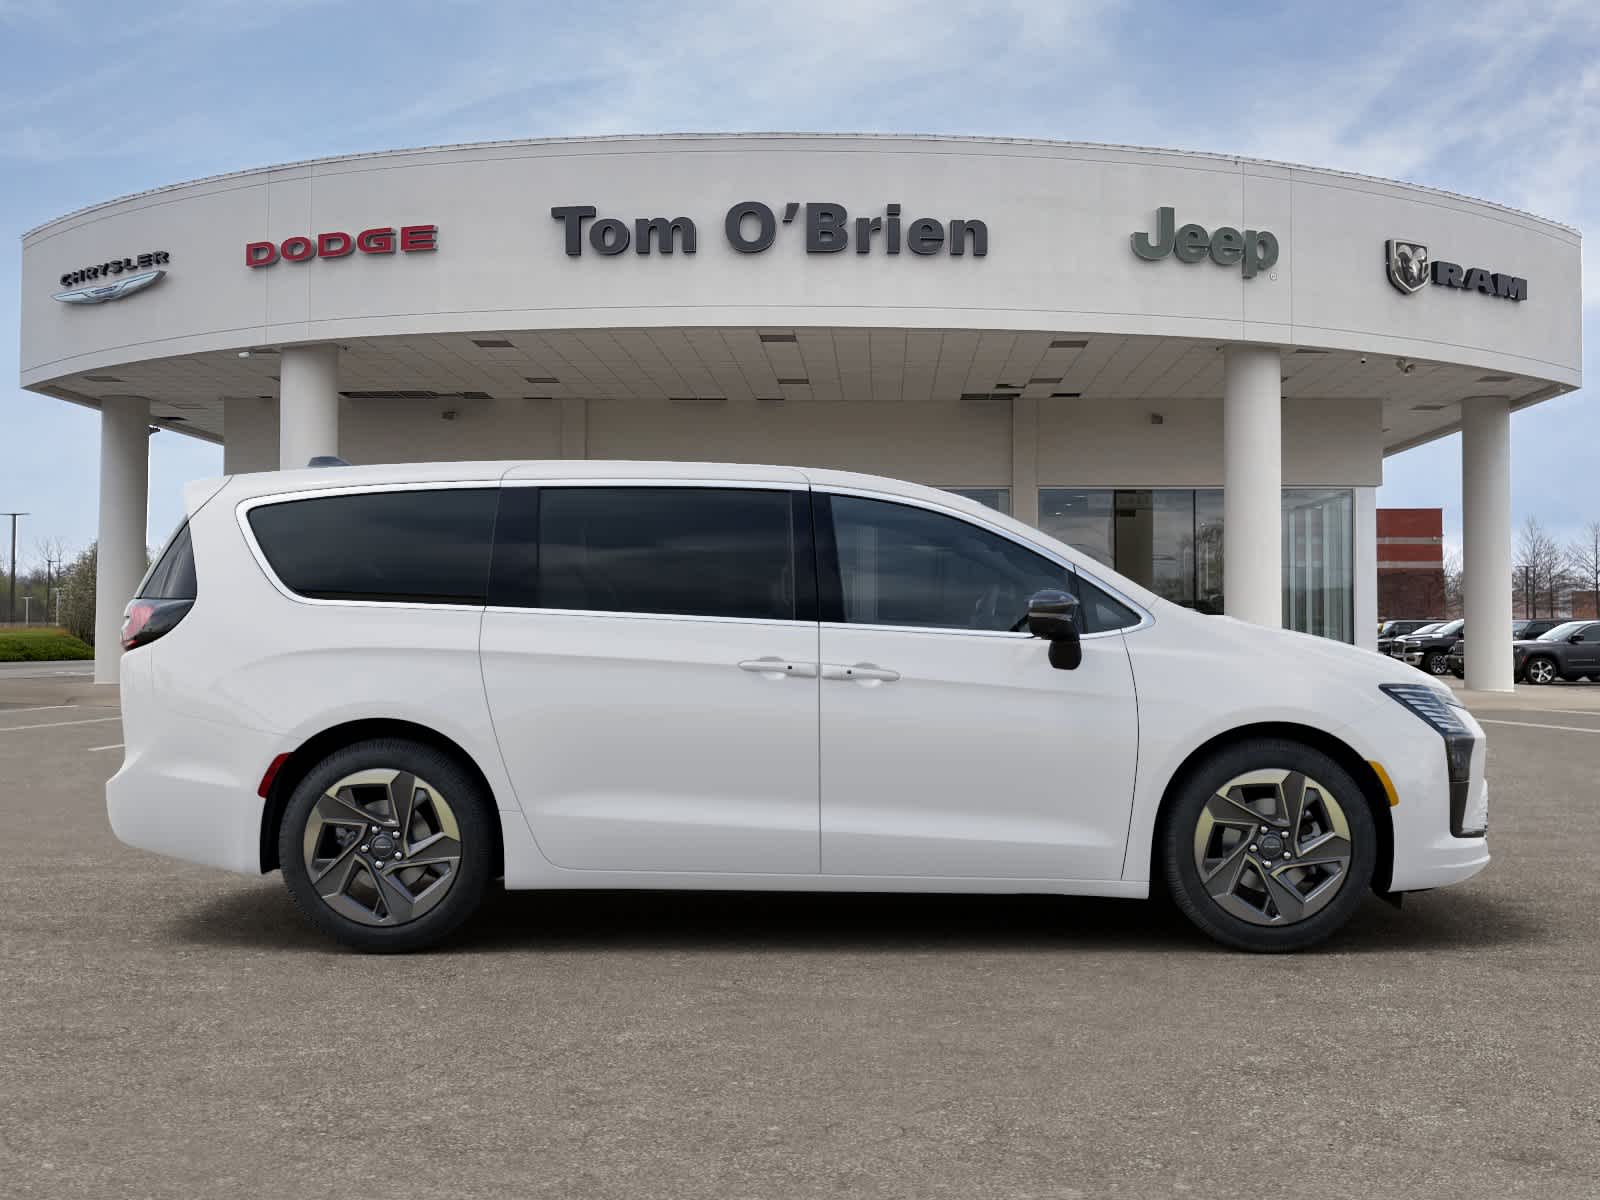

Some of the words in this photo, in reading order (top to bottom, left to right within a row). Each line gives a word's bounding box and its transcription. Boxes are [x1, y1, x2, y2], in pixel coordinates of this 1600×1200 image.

[245, 225, 438, 268] DODGE
[551, 205, 697, 256] Tom
[1130, 207, 1279, 279] Jeep
[60, 250, 170, 287] CHRYSLER
[1431, 260, 1528, 302] RAM
